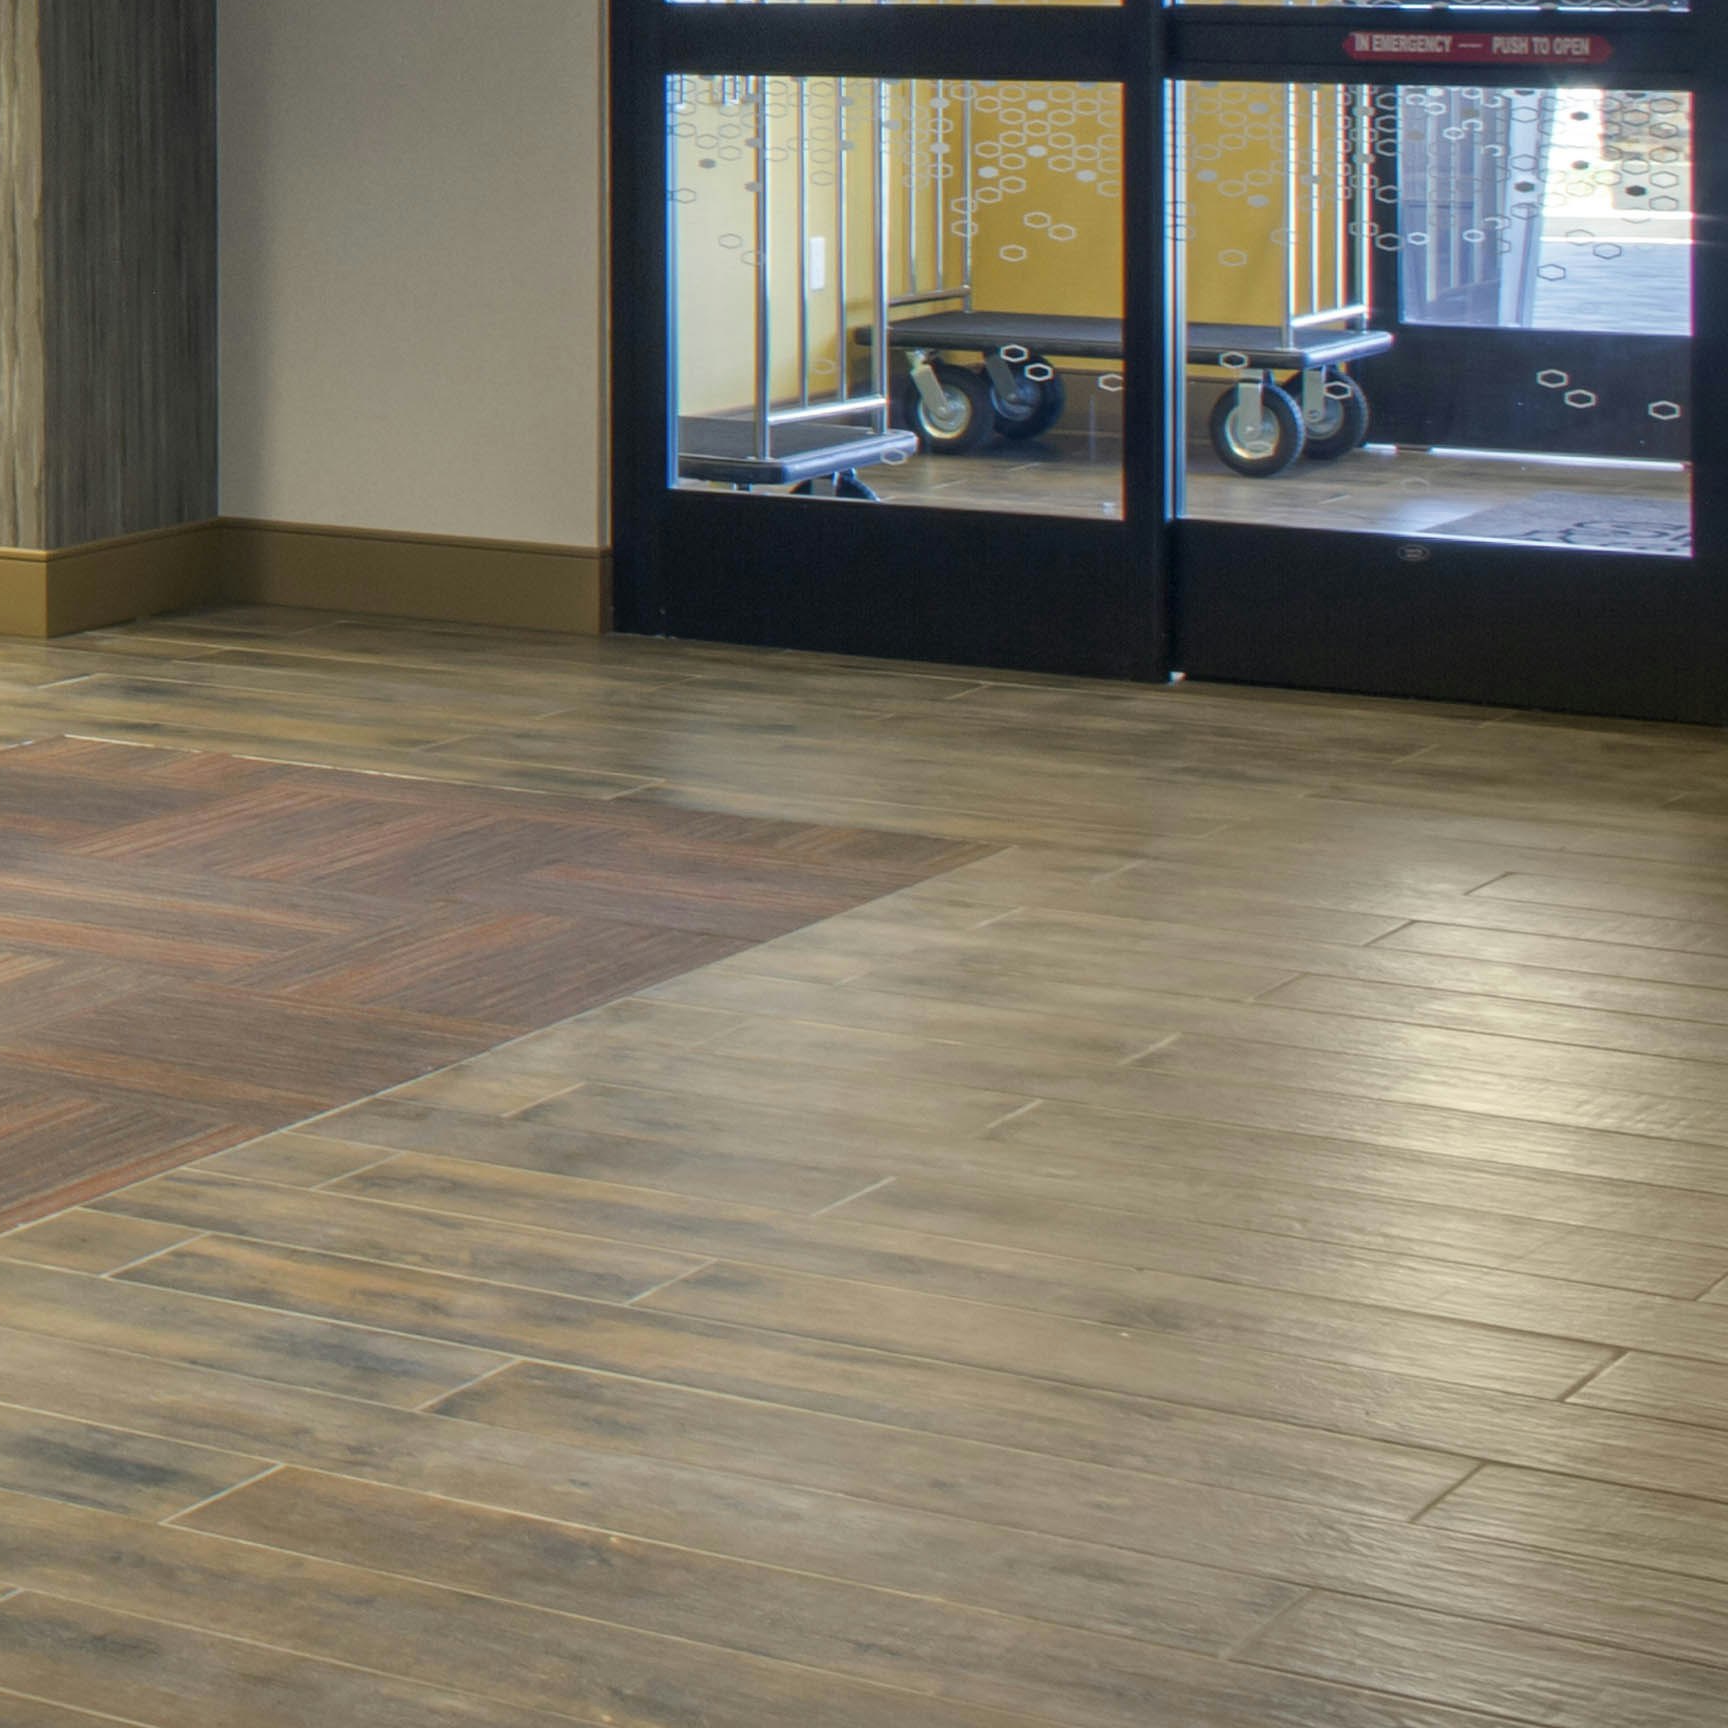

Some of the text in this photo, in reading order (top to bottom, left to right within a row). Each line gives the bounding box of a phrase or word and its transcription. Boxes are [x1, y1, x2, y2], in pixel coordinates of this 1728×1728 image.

[1353, 32, 1591, 56] IN EMERGENCY PUSH TO OPEN
